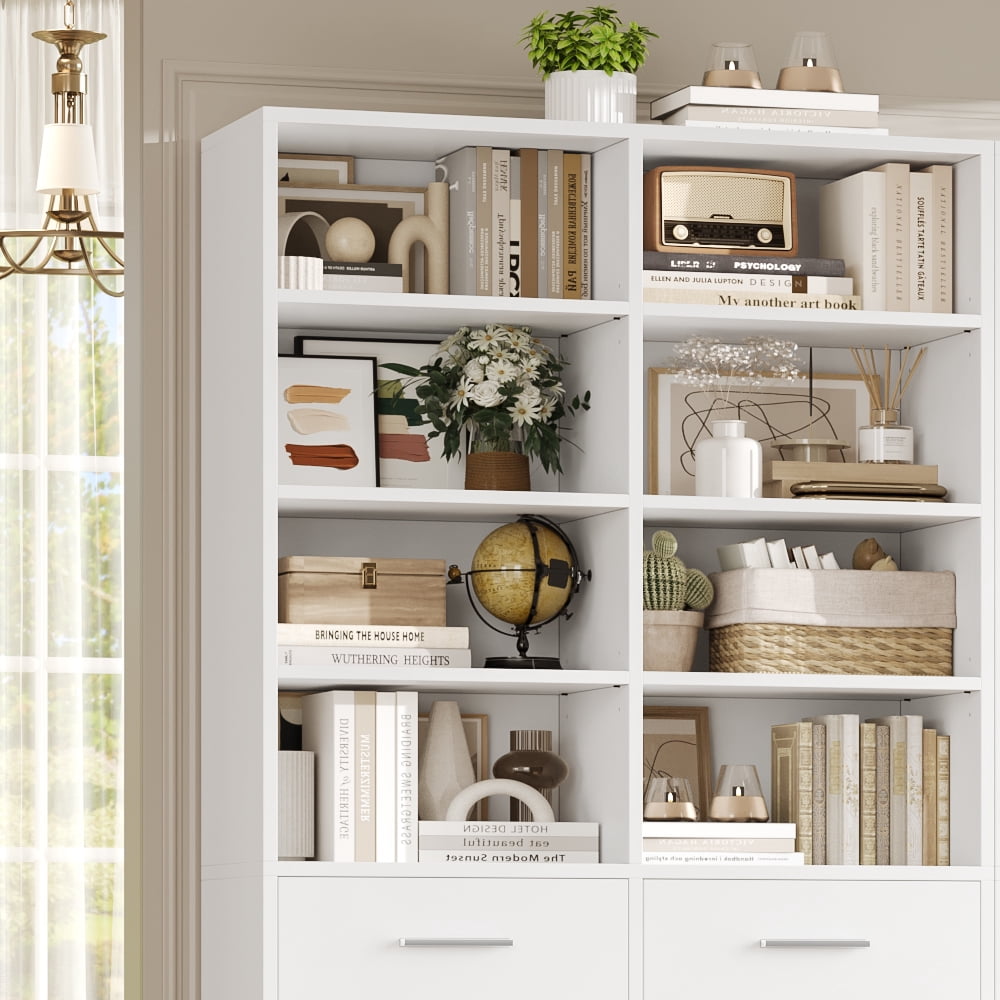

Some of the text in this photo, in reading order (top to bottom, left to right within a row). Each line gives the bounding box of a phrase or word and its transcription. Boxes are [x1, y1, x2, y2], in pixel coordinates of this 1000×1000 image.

[871, 238, 880, 253] black
[917, 197, 926, 300] SOUFFLÉS TARTE TATIN GÂTEAUX
[734, 261, 802, 271] PSYCHOLOGY
[651, 275, 672, 284] ELLEN
[714, 277, 743, 285] LUPTON
[749, 278, 803, 288] DESIGN
[718, 294, 857, 310] My another art book
[315, 630, 425, 642] BRINGING THE HOUSE HOME
[332, 653, 450, 666] WUTHERING HEIGHTS
